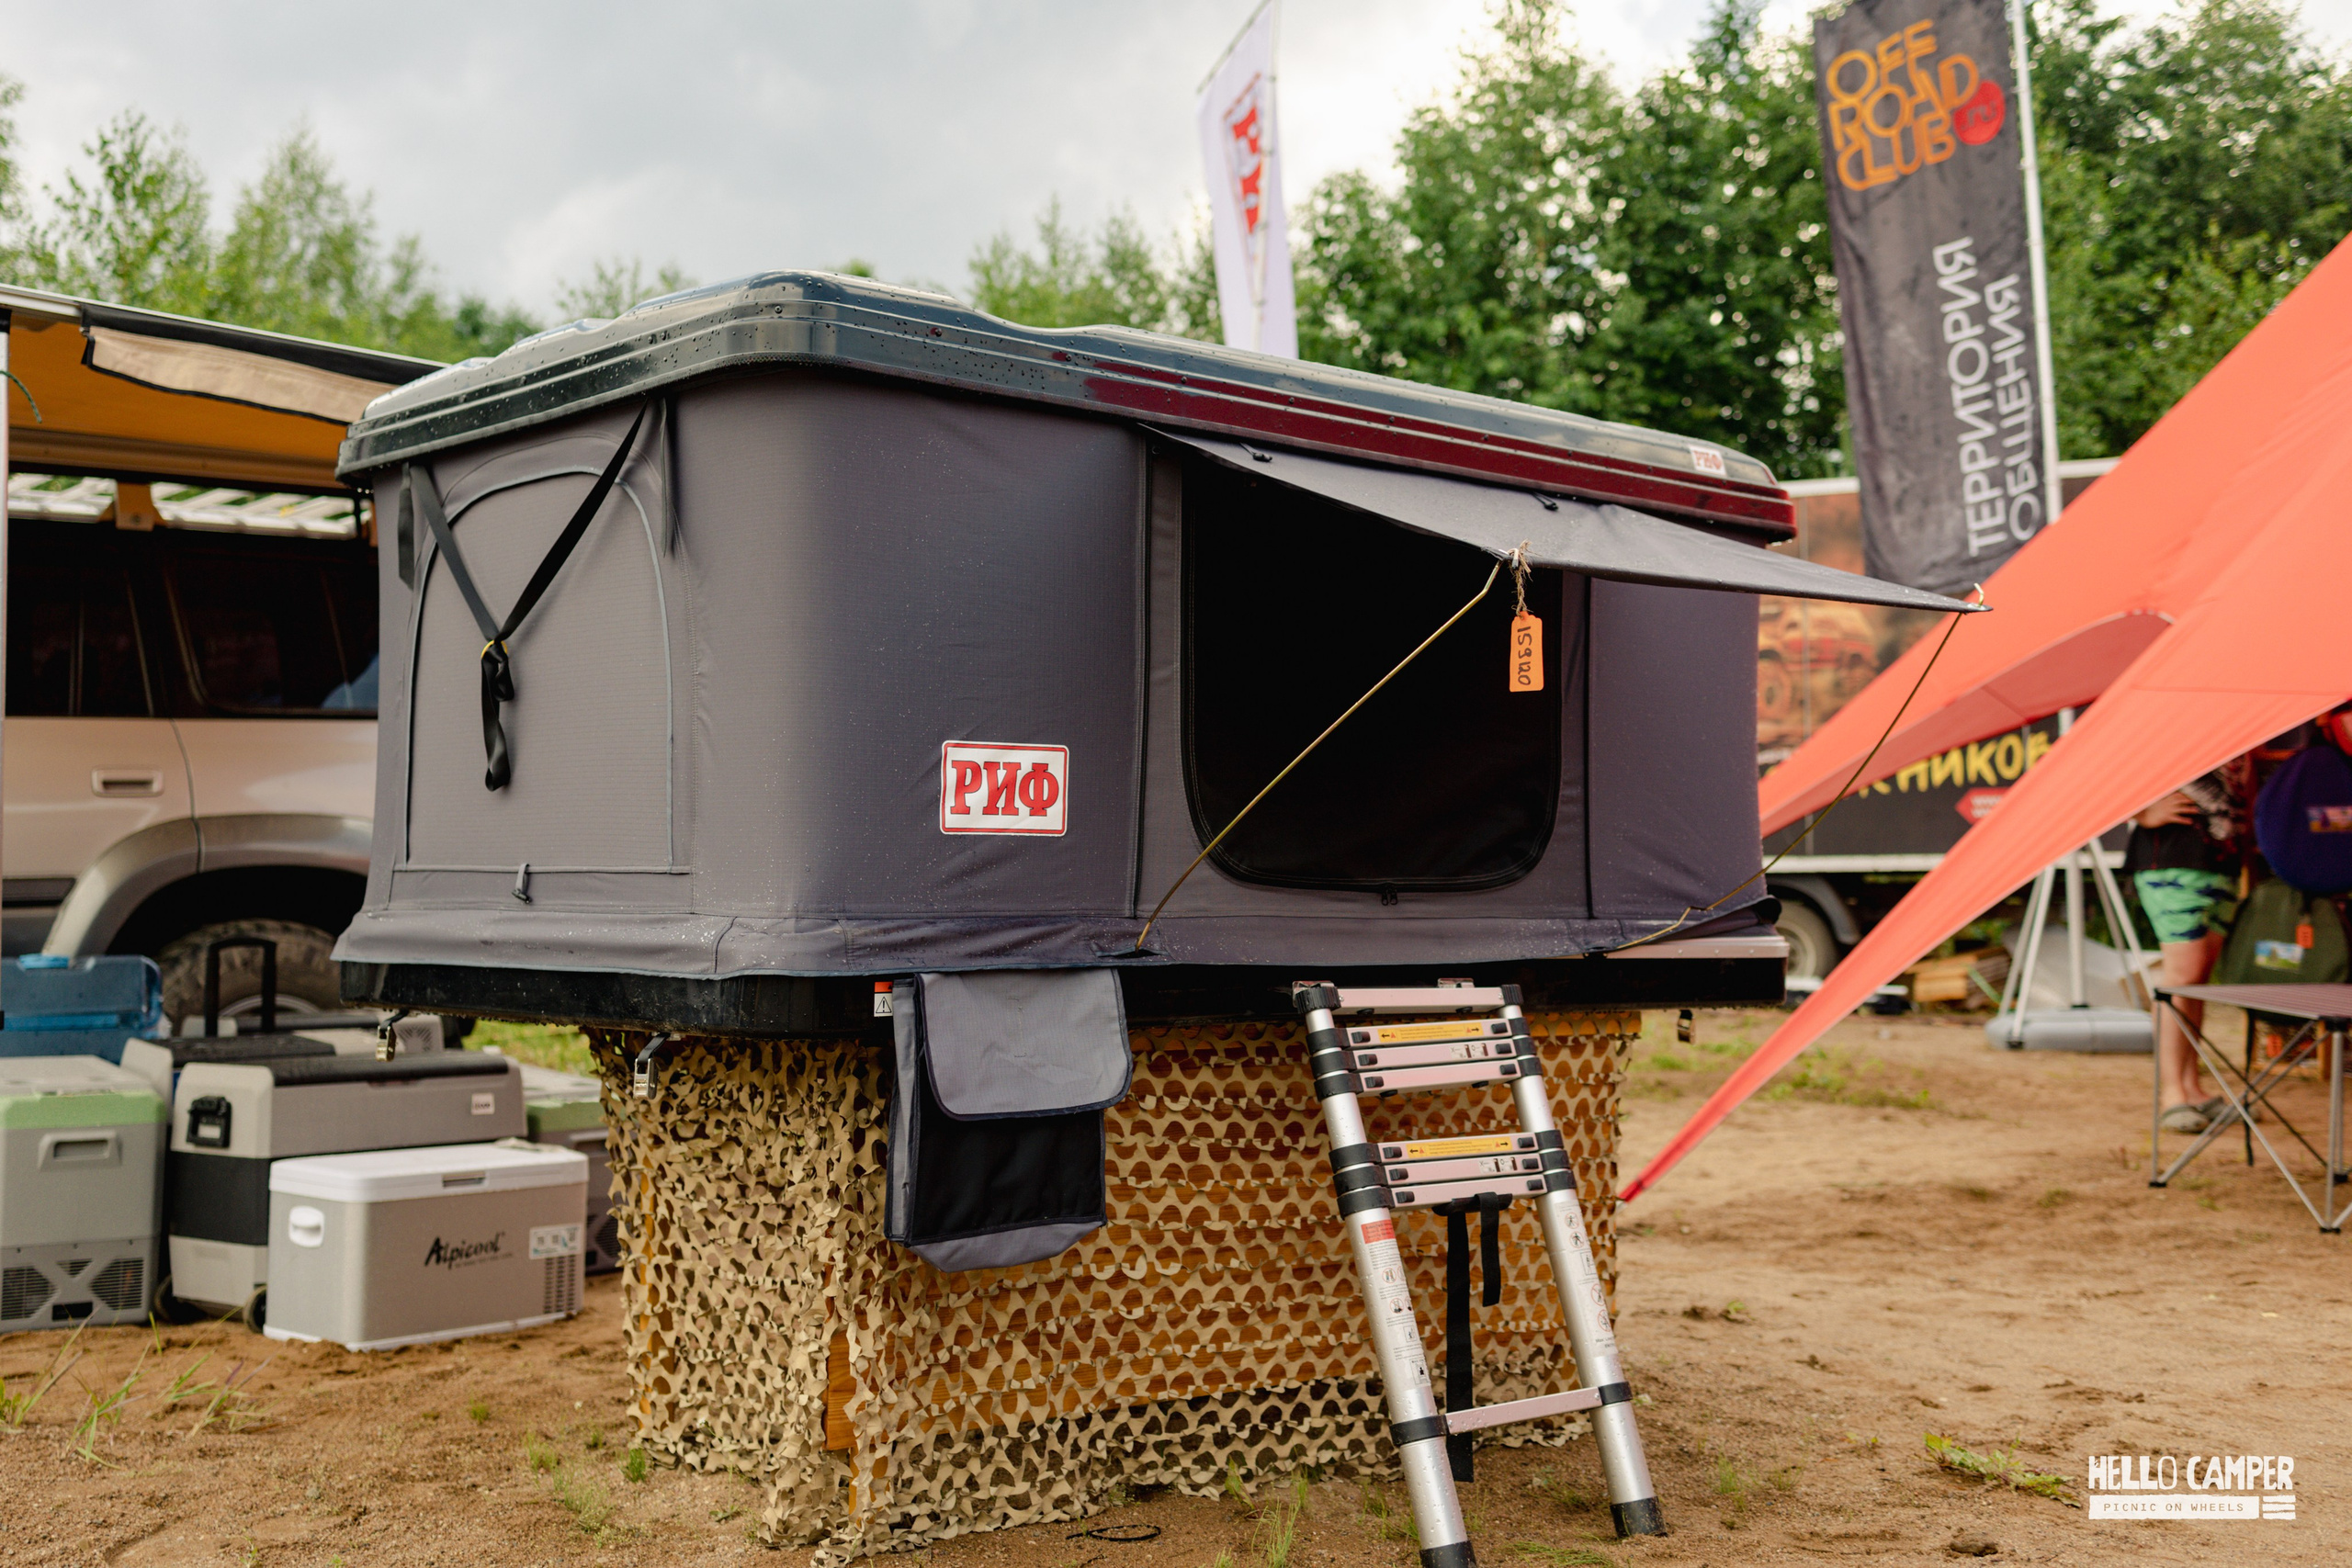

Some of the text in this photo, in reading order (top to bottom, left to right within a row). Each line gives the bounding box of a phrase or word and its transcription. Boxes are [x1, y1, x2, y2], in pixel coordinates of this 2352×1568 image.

[1826, 18, 1938, 103] OFF
[1828, 53, 1979, 151] ROAD
[1837, 111, 1956, 191] CLUB
[1932, 236, 2008, 557] ТЕРРИТОРИЯ
[1984, 273, 2041, 540] ОБЩЕНИЯ
[950, 760, 1059, 817] РИФ
[424, 1232, 501, 1270] Alpicool
